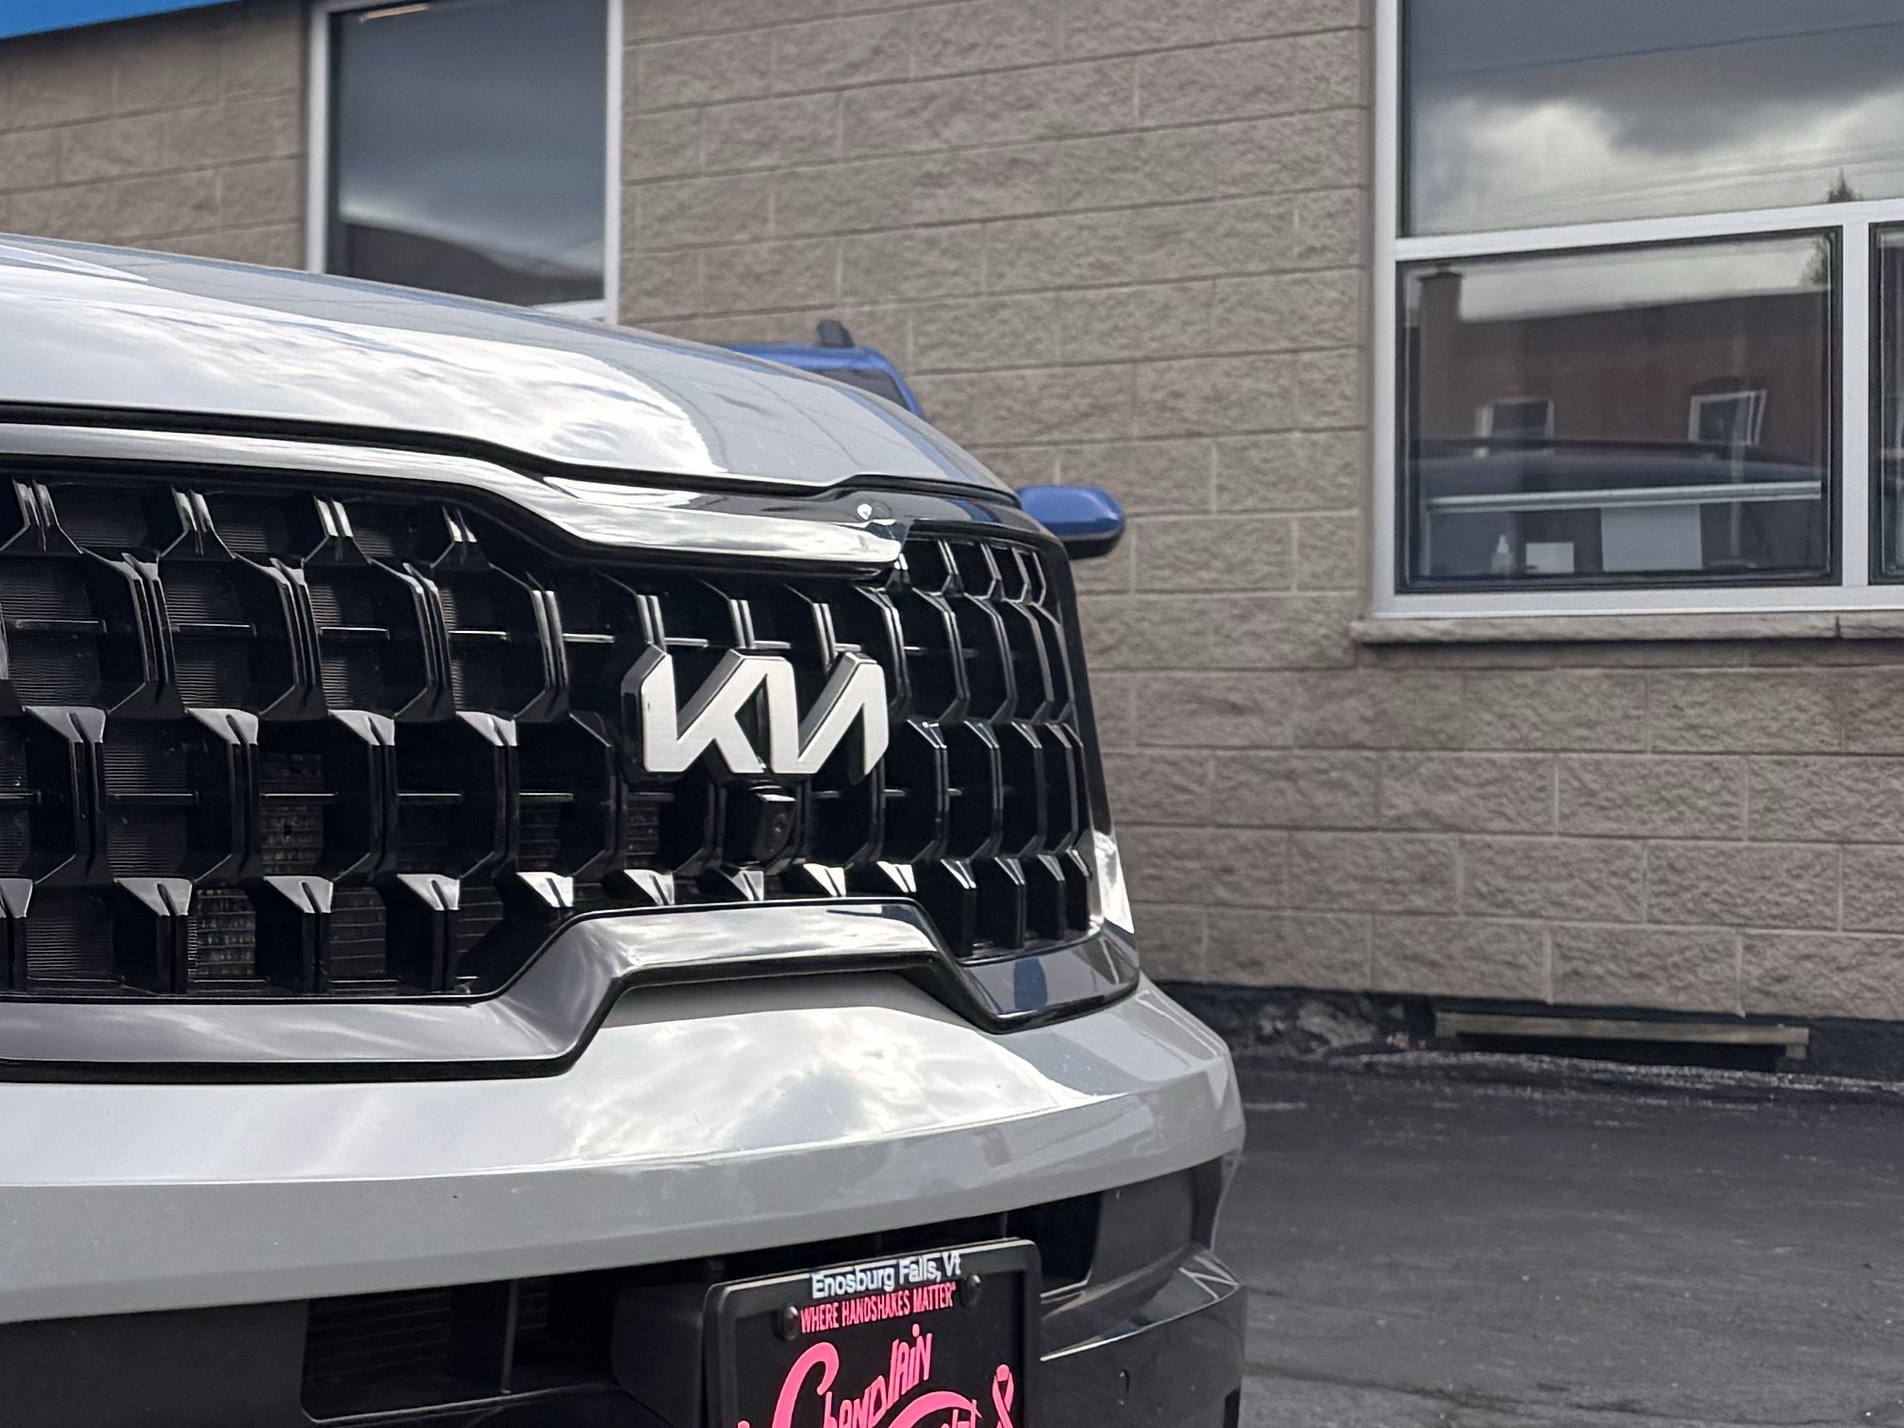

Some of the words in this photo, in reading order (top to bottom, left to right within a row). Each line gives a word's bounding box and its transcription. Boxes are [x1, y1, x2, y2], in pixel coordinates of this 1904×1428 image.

[624, 643, 889, 776] KIA
[811, 1267, 896, 1300] Enosburg
[899, 1256, 942, 1285] Falls,
[943, 1251, 962, 1277] Vt
[800, 1302, 840, 1334] WHERE
[841, 1289, 911, 1327] HANDSHAKES
